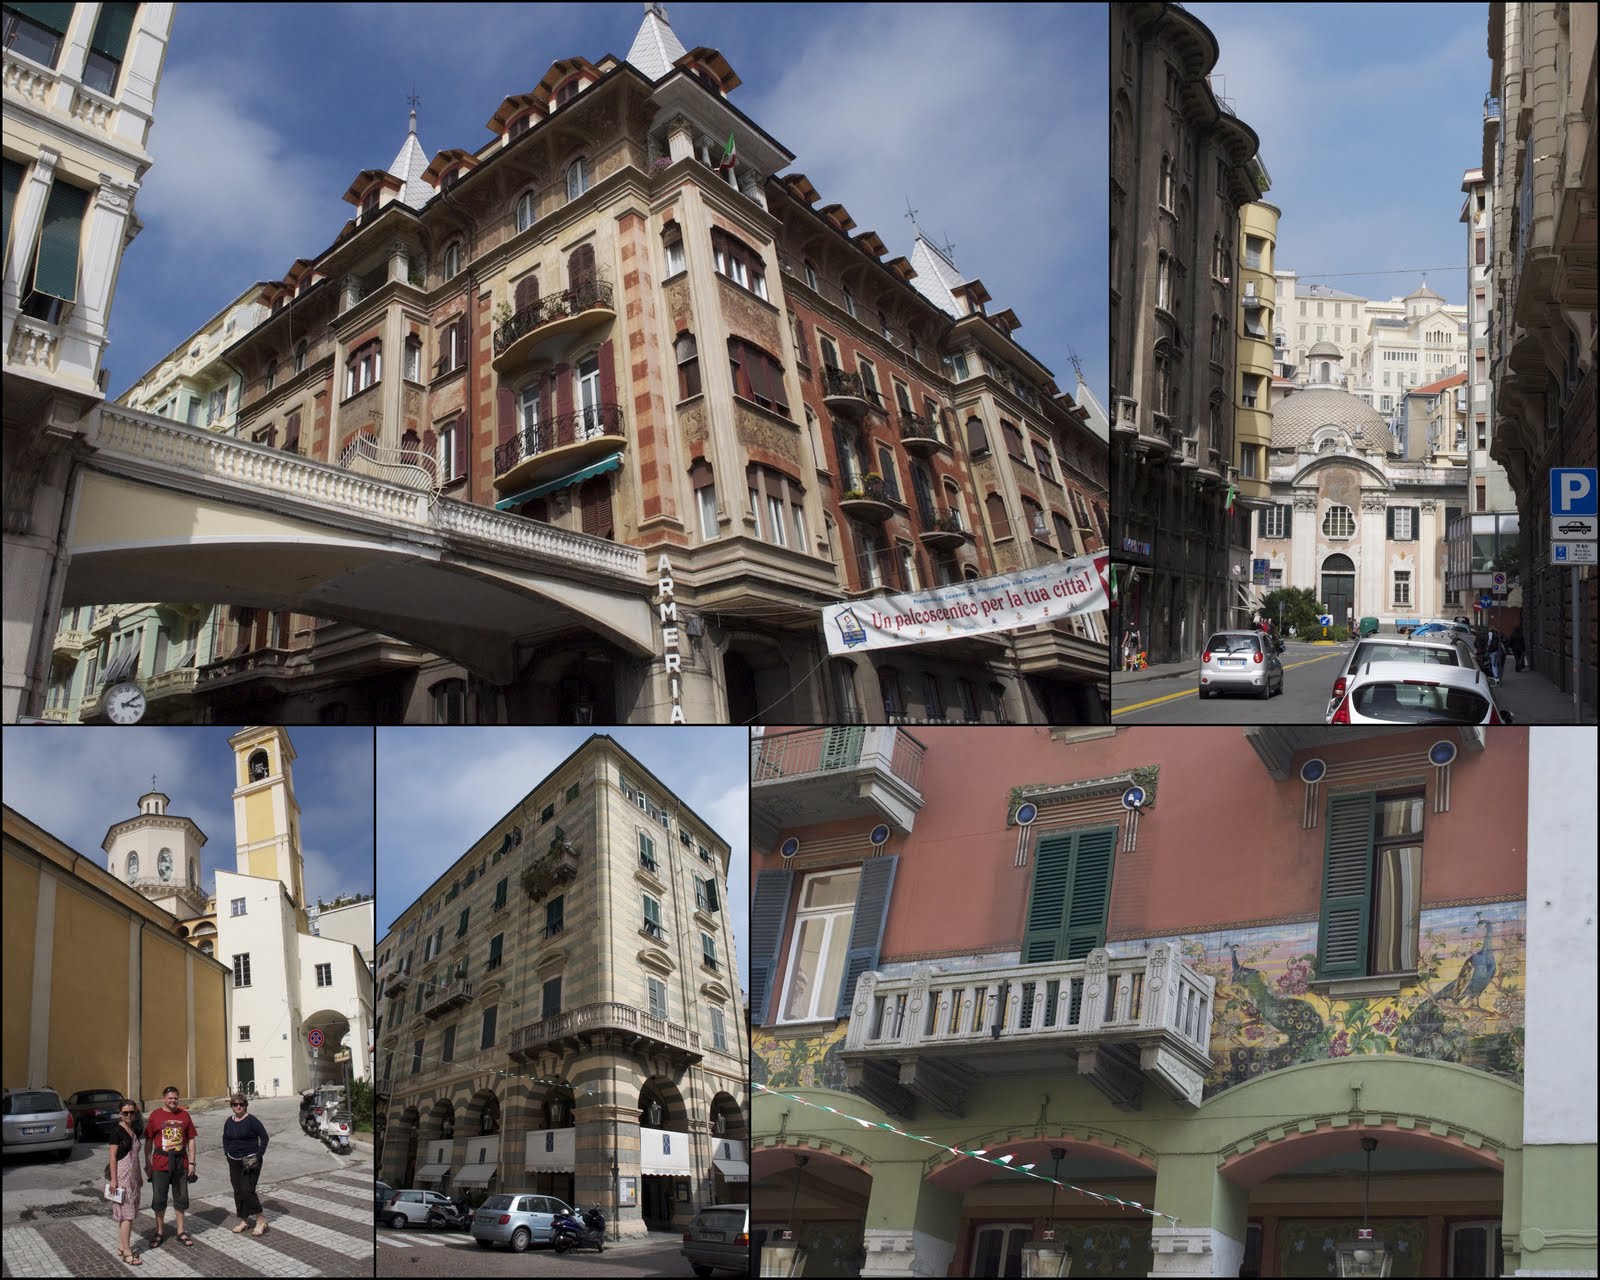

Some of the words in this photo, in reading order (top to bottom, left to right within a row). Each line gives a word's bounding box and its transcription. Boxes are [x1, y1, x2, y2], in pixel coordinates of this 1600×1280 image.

[1561, 473, 1590, 510] P
[872, 611, 891, 630] Un
[895, 602, 978, 630] palcoscenico
[980, 597, 1004, 617] per
[1005, 589, 1024, 608] la
[1024, 588, 1051, 605] tua
[1053, 570, 1093, 598] città!
[1024, 574, 1047, 583] Cultura
[657, 553, 686, 724] ARMERIA
